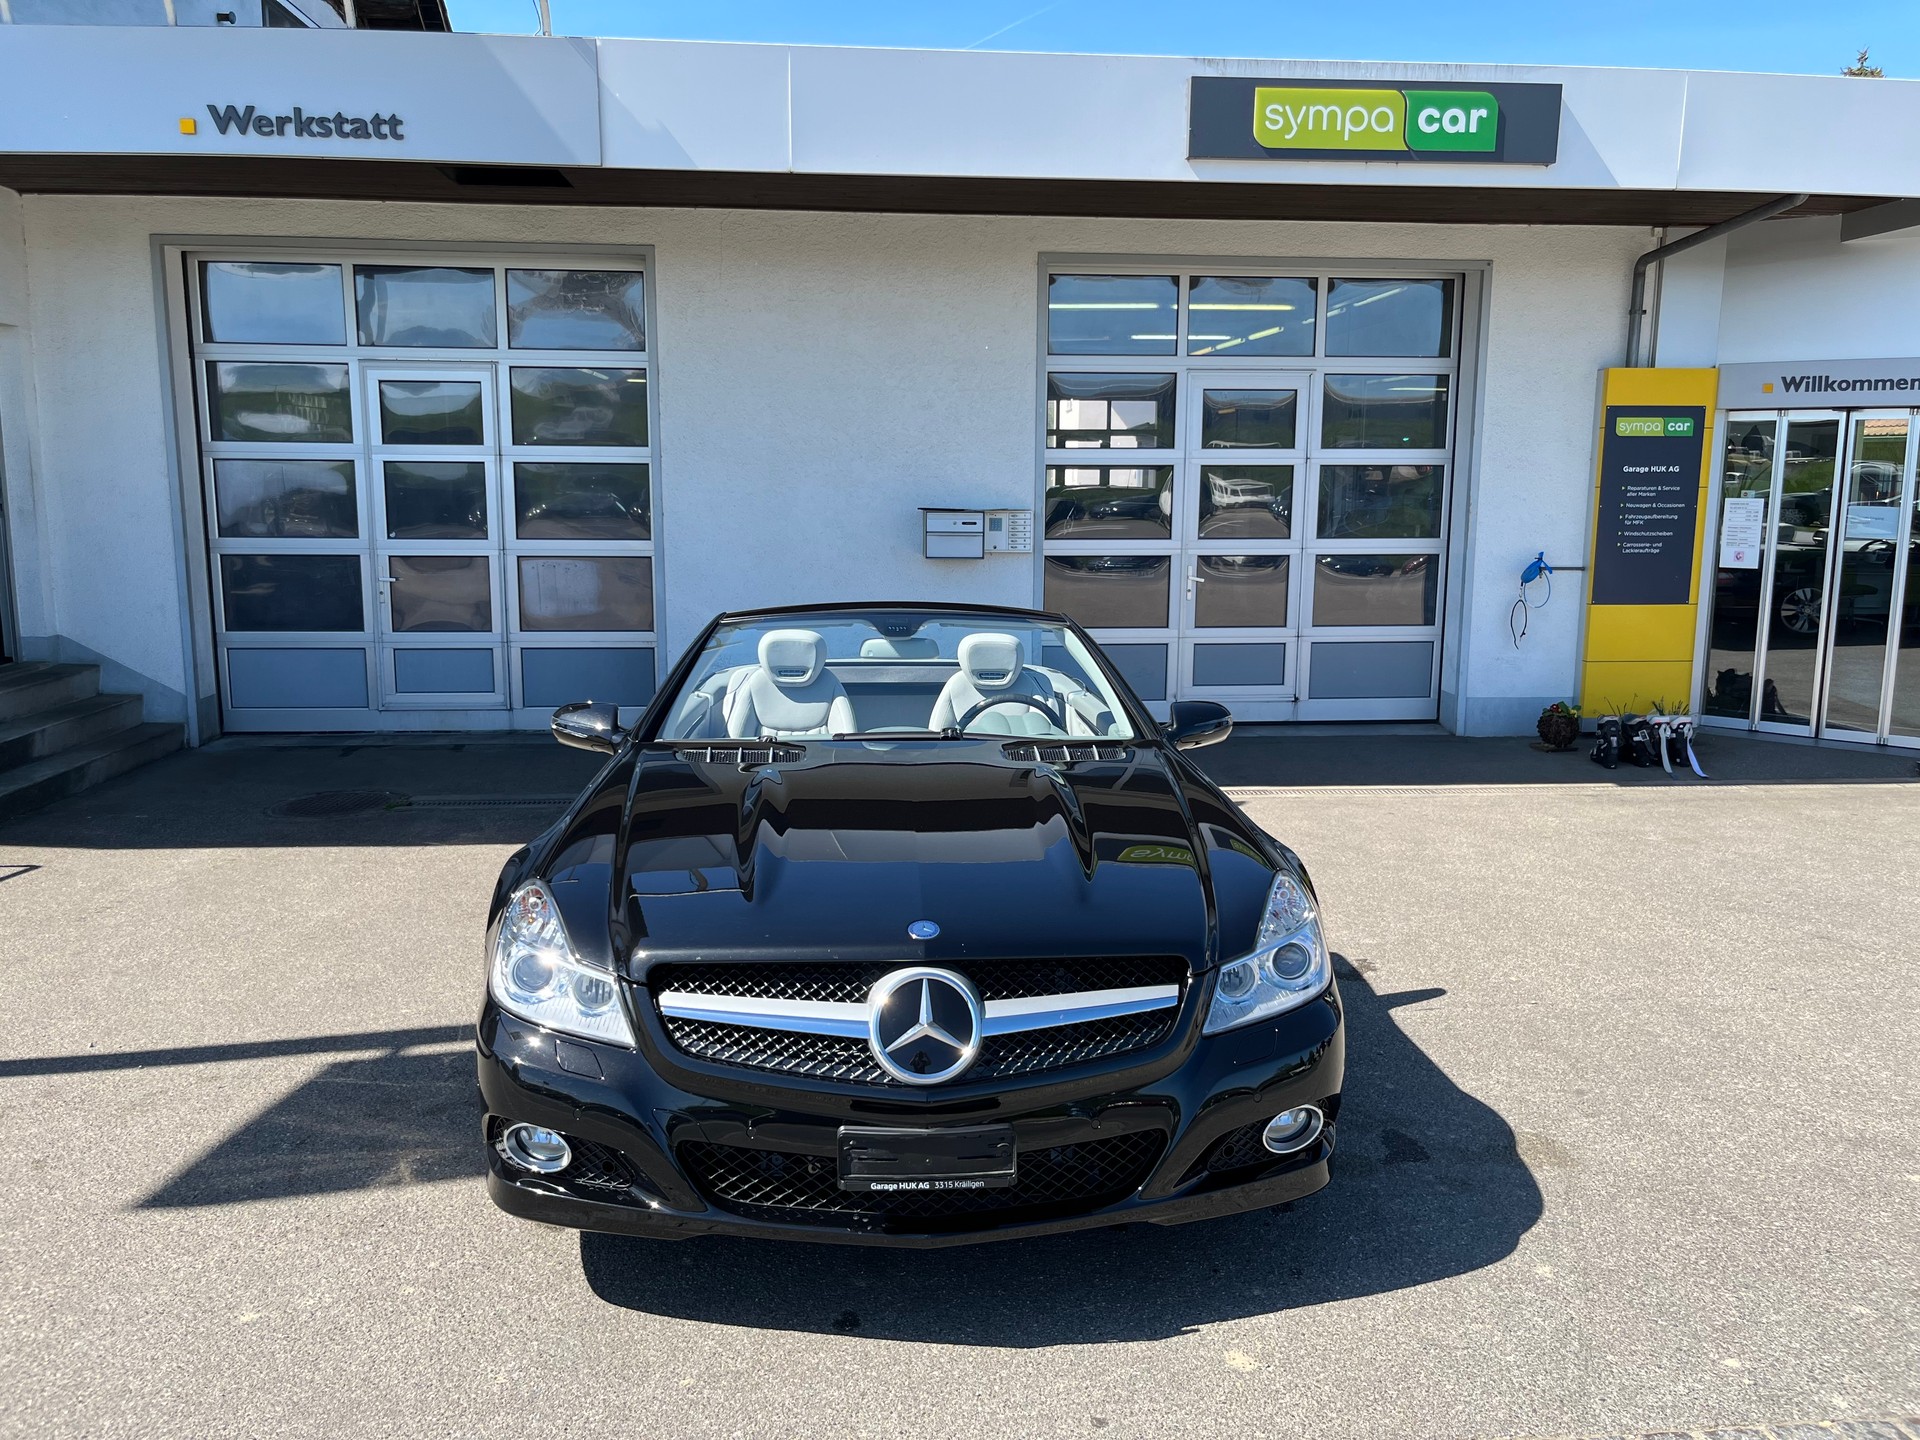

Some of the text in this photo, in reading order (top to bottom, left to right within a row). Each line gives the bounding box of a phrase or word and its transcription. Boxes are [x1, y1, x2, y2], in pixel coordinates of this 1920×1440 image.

[206, 104, 405, 141] Werkstatt
[1264, 103, 1488, 141] sympa car
[1780, 374, 1920, 393] Willkommen
[1619, 422, 1691, 434] sympa car
[1622, 465, 1680, 474] Garage HUK AG
[870, 1182, 898, 1192] Garage
[899, 1182, 918, 1190] HUK
[917, 1181, 930, 1189] AG
[934, 1181, 953, 1189] 3315
